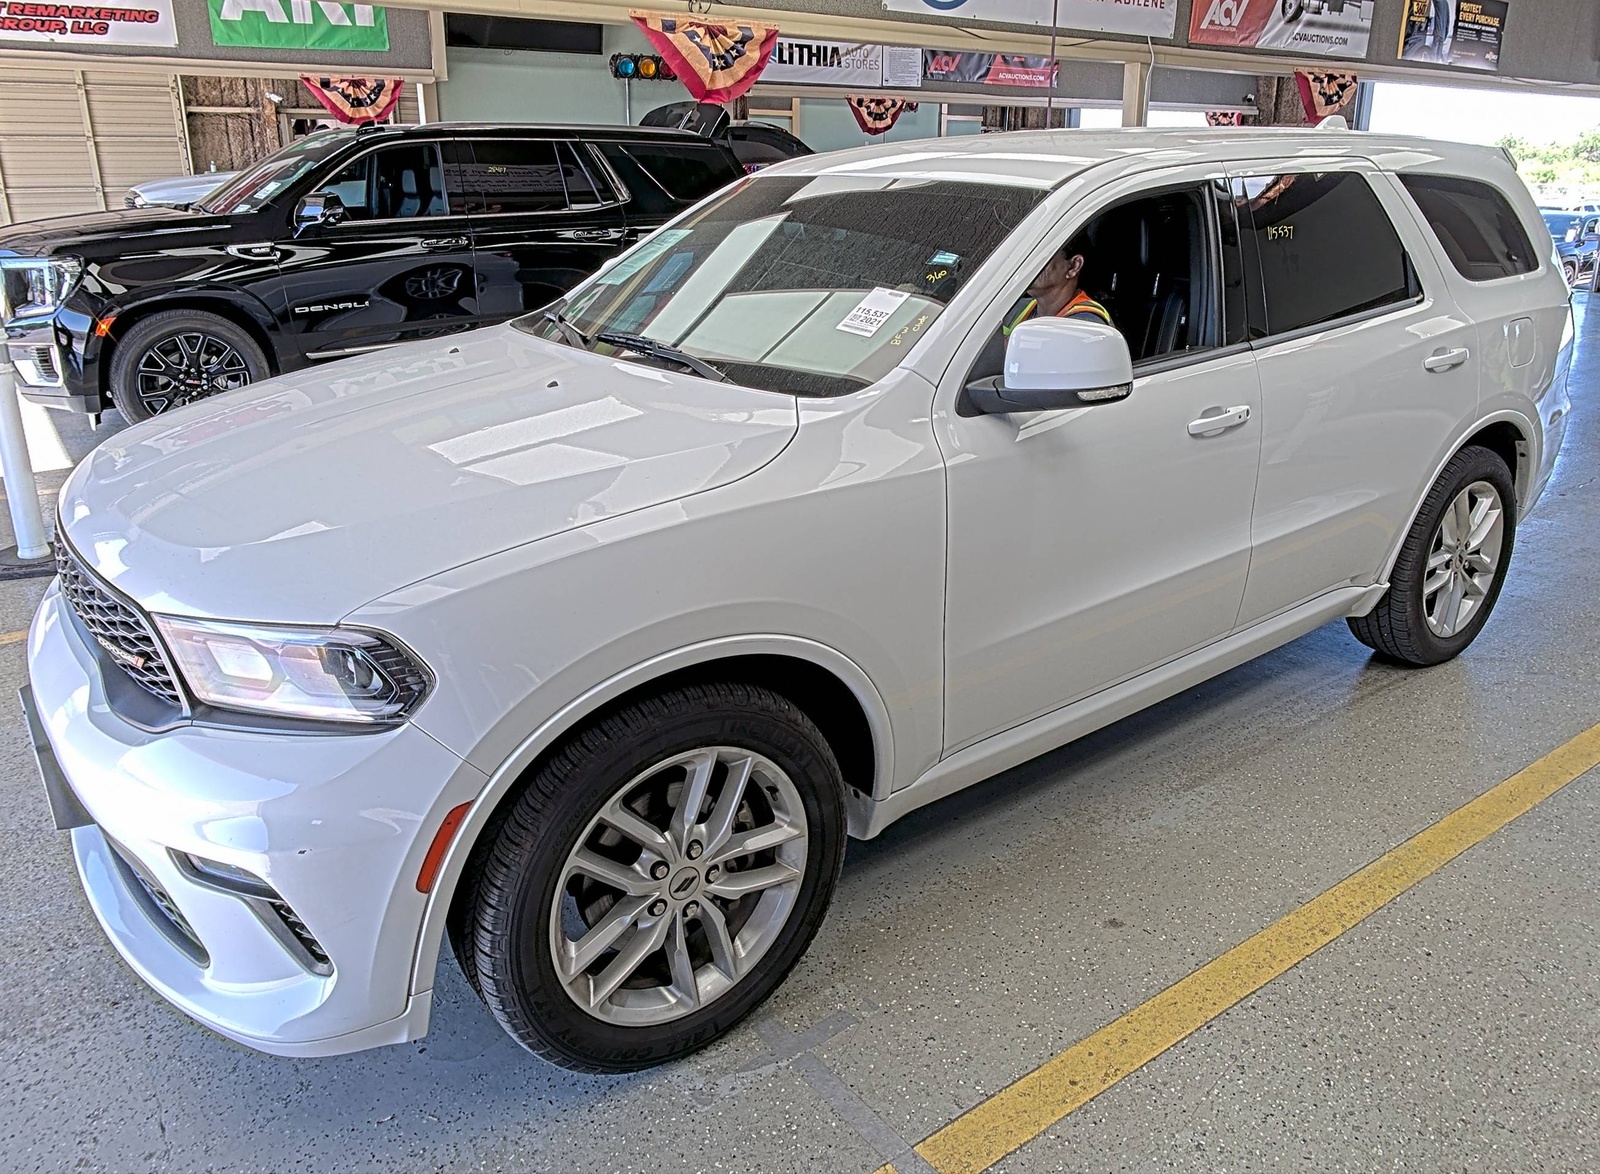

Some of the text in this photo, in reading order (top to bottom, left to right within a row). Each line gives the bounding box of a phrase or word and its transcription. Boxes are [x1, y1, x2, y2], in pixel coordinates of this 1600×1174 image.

[7, 2, 159, 23] REMARKETING
[1200, 0, 1249, 30] ACV
[1460, 2, 1482, 14] PROTECT
[1458, 11, 1500, 27] EVERY PURCHASE
[70, 21, 109, 35] LLC
[777, 42, 869, 68] LITHIA AUTO
[844, 58, 880, 71] STORES
[929, 53, 962, 73] ACV
[998, 72, 1045, 82] ACVAUCTIONS.COM
[1267, 225, 1294, 241] 115537
[295, 301, 370, 314] DENALI
[855, 306, 891, 319] 115,537
[860, 316, 882, 326] 2021
